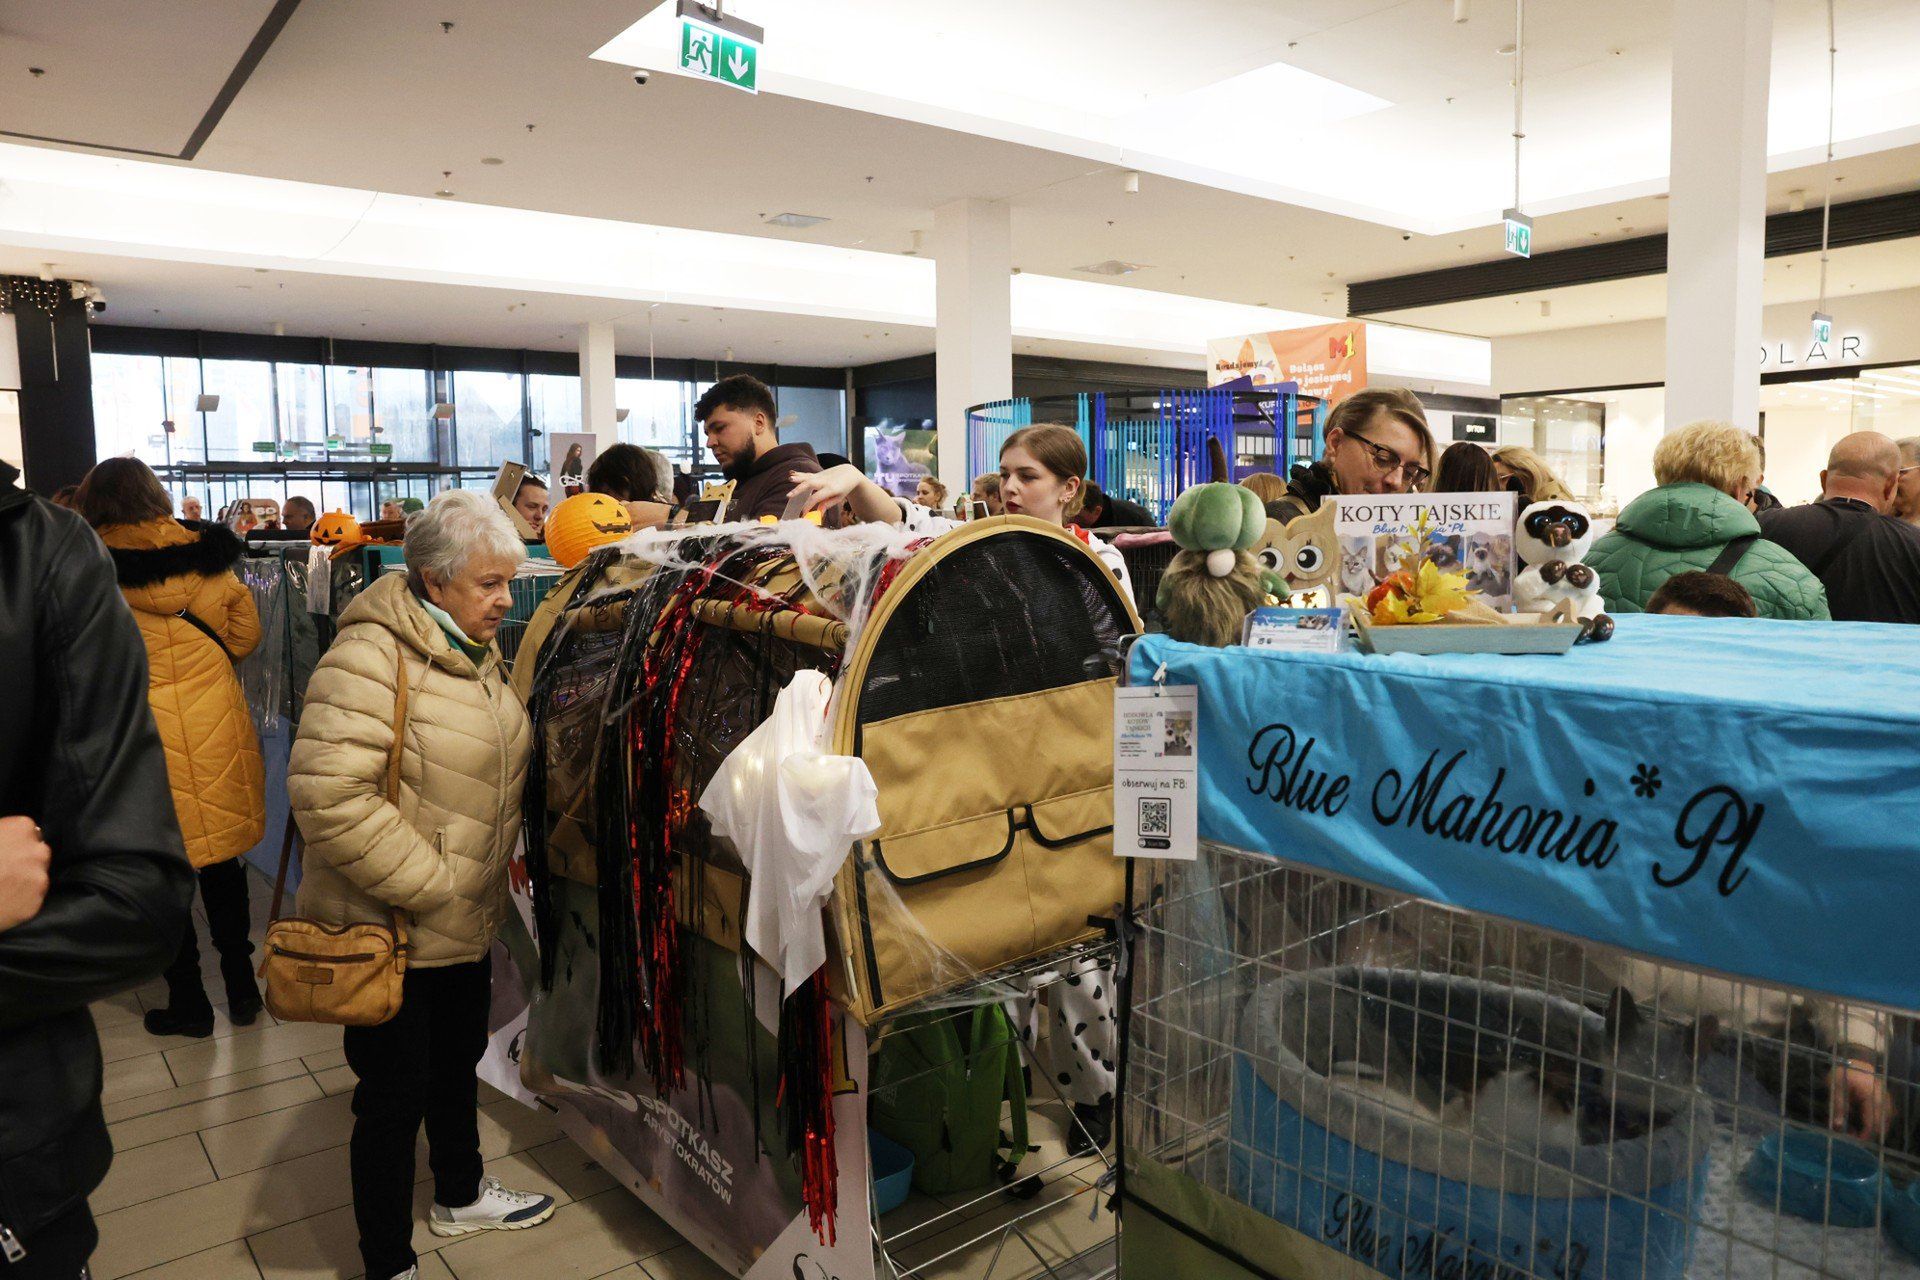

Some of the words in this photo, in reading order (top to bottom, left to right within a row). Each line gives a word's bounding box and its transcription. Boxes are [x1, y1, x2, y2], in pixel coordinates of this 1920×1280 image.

[1329, 332, 1355, 360] M1
[1341, 505, 1405, 523] KOTY
[1409, 503, 1502, 526] TAJSKIE
[1372, 523, 1398, 535] Blue
[1122, 778, 1157, 791] obserwuj
[1246, 723, 1351, 818] Blue
[1371, 748, 1620, 870] Mahonia
[636, 1094, 734, 1186] SPOTKASZ
[643, 1112, 732, 1206] ARYSTOKRATÓW
